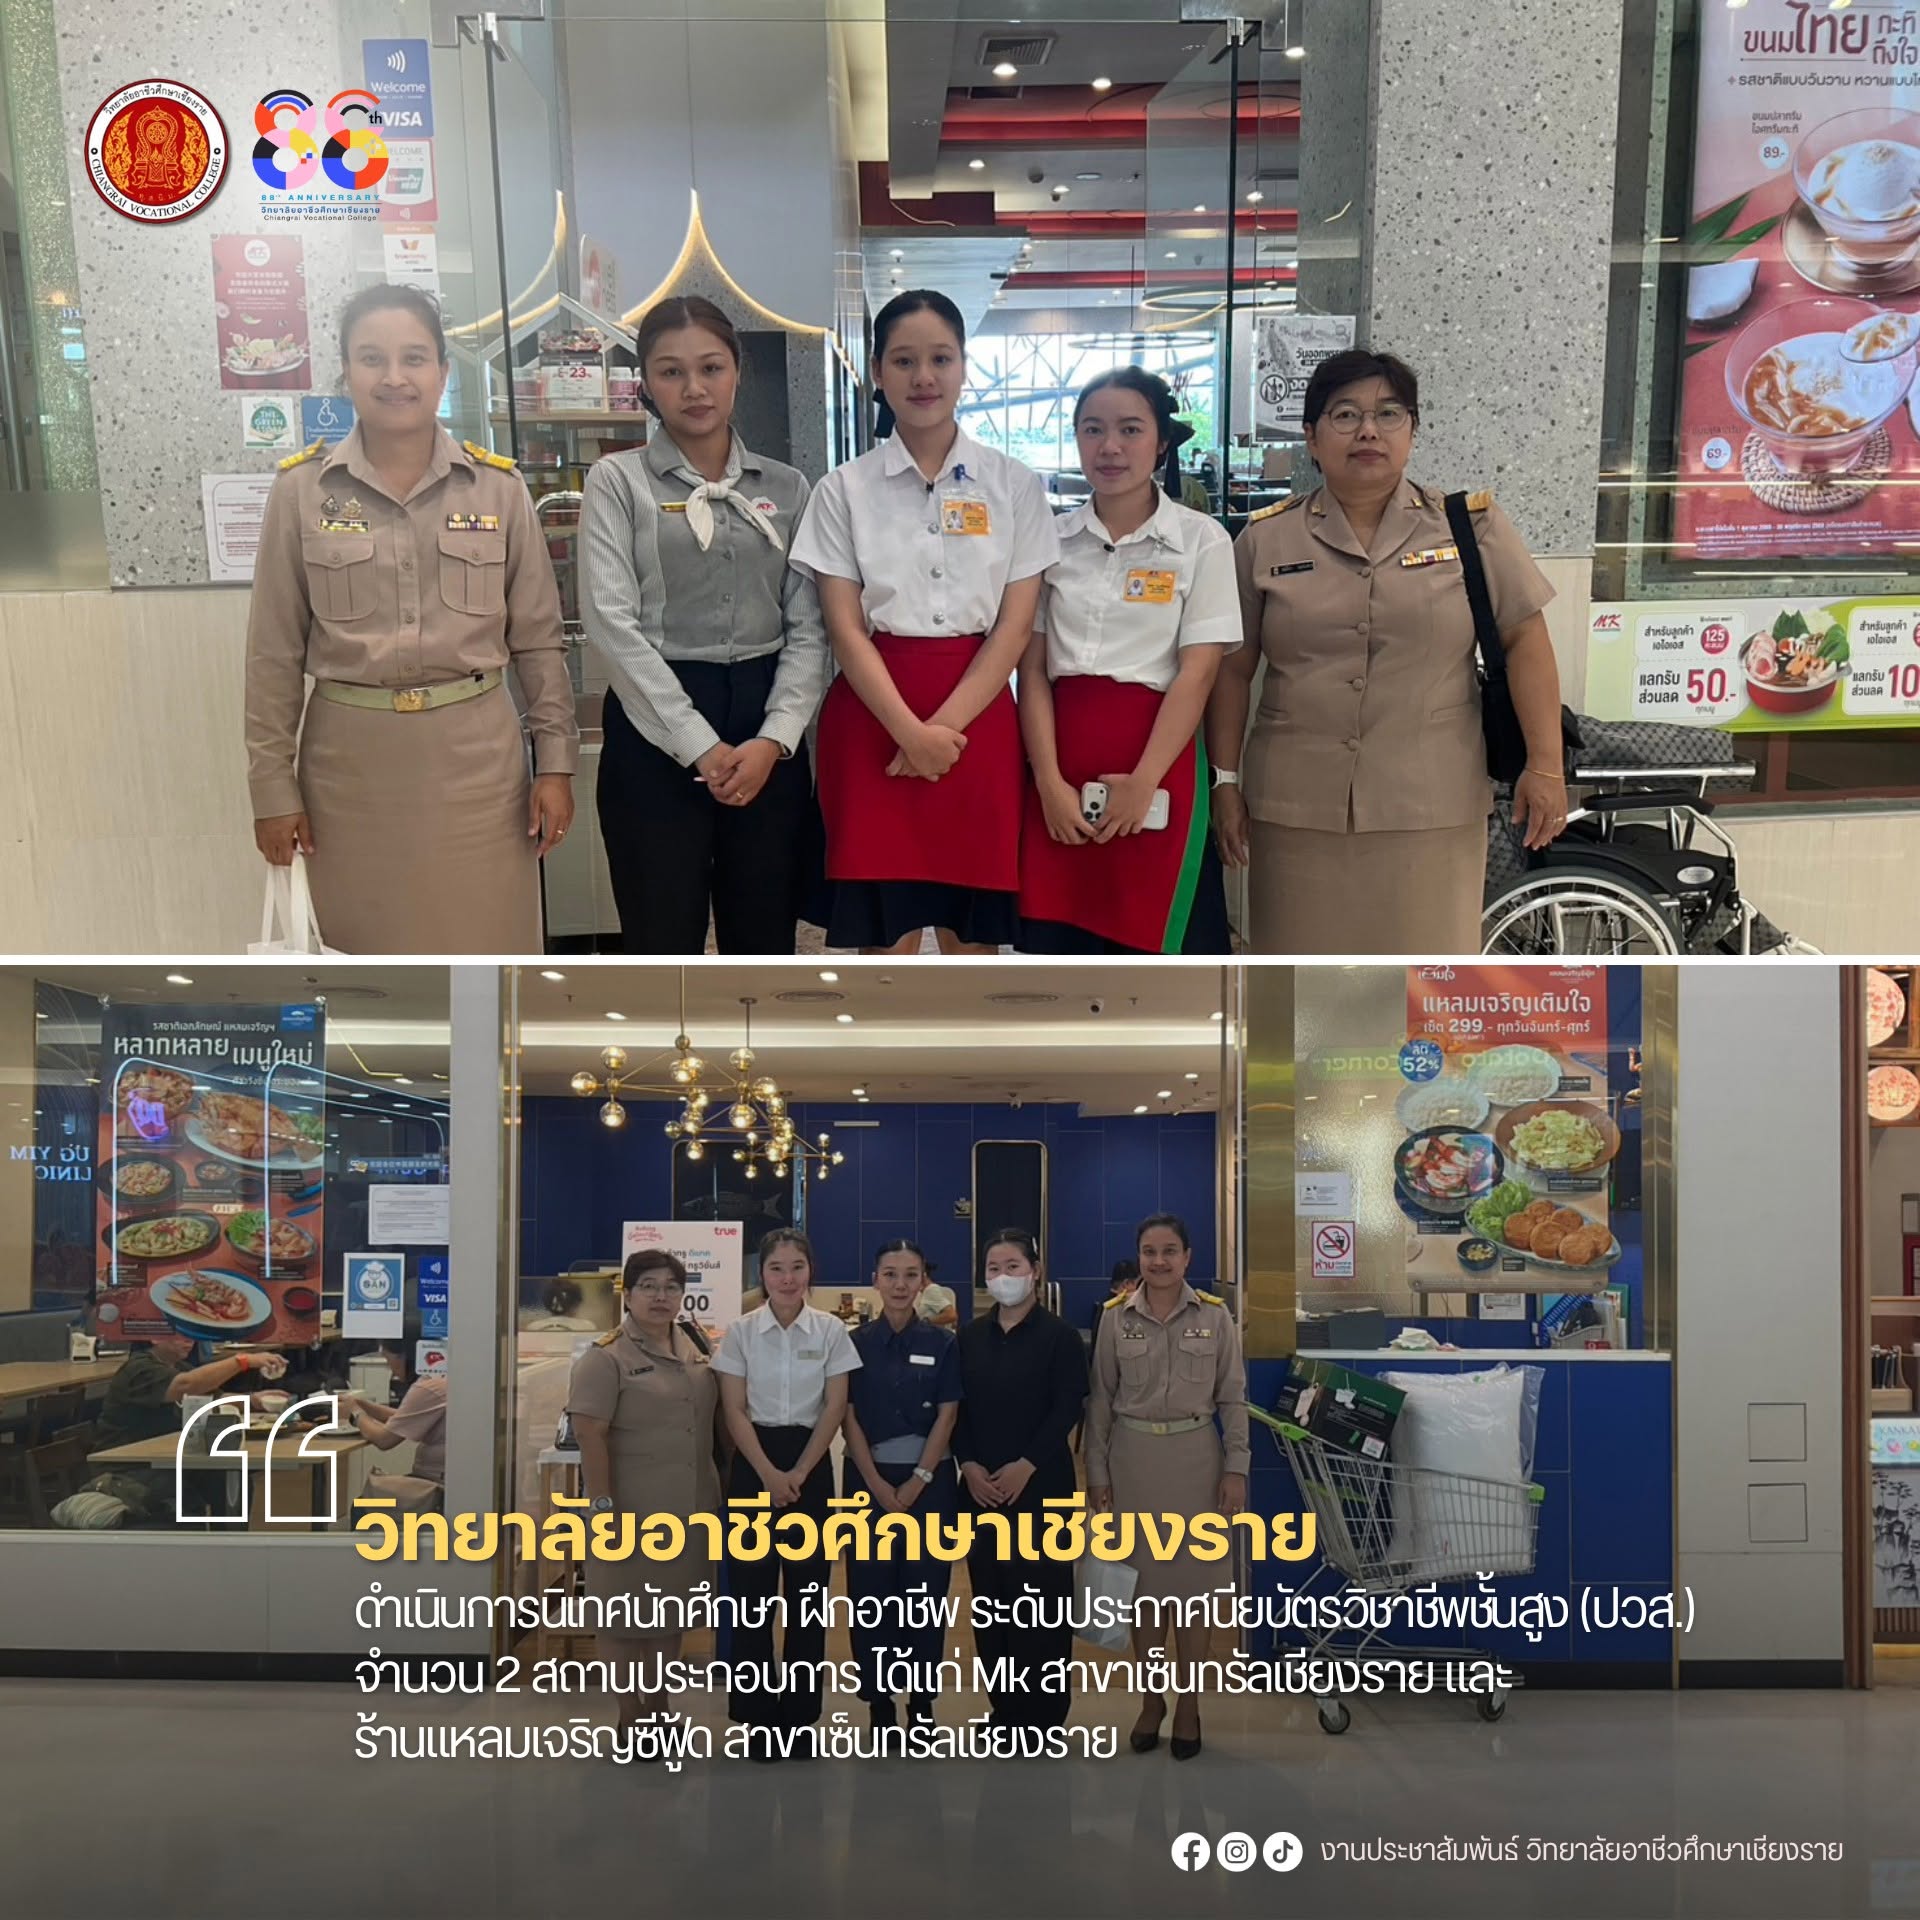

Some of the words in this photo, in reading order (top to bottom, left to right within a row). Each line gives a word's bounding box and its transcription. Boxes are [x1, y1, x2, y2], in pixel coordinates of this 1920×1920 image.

[1738, 72, 1851, 87] รสชาติแบบวันวาน
[370, 80, 426, 94] Welcome
[380, 110, 423, 127] VISA
[1593, 614, 1622, 627] MK
[1859, 620, 1908, 634] สำหรับลูกค้า
[1644, 625, 1694, 640] สำหรับลูกค้า
[1705, 628, 1725, 642] 125
[1866, 634, 1898, 645] เอไอเอส
[1652, 639, 1684, 651] เอไอเอส
[1639, 670, 1681, 686] แลกรับ
[1852, 669, 1885, 682] แลกรับ
[1638, 688, 1679, 704] ส่วนลด
[1851, 684, 1884, 696] ส่วนลด
[1423, 989, 1592, 1016] แหลมเจริญเติมใจ
[1496, 1019, 1591, 1036] ทุกวันจันทร์-ศุกร์
[113, 1036, 230, 1056] หลากหลาย
[233, 1039, 313, 1073] เมนูใหม่
[1402, 1056, 1440, 1072] 52%
[713, 1226, 738, 1236] true
[1315, 1258, 1335, 1270] ห้าม
[423, 1294, 447, 1303] VISA
